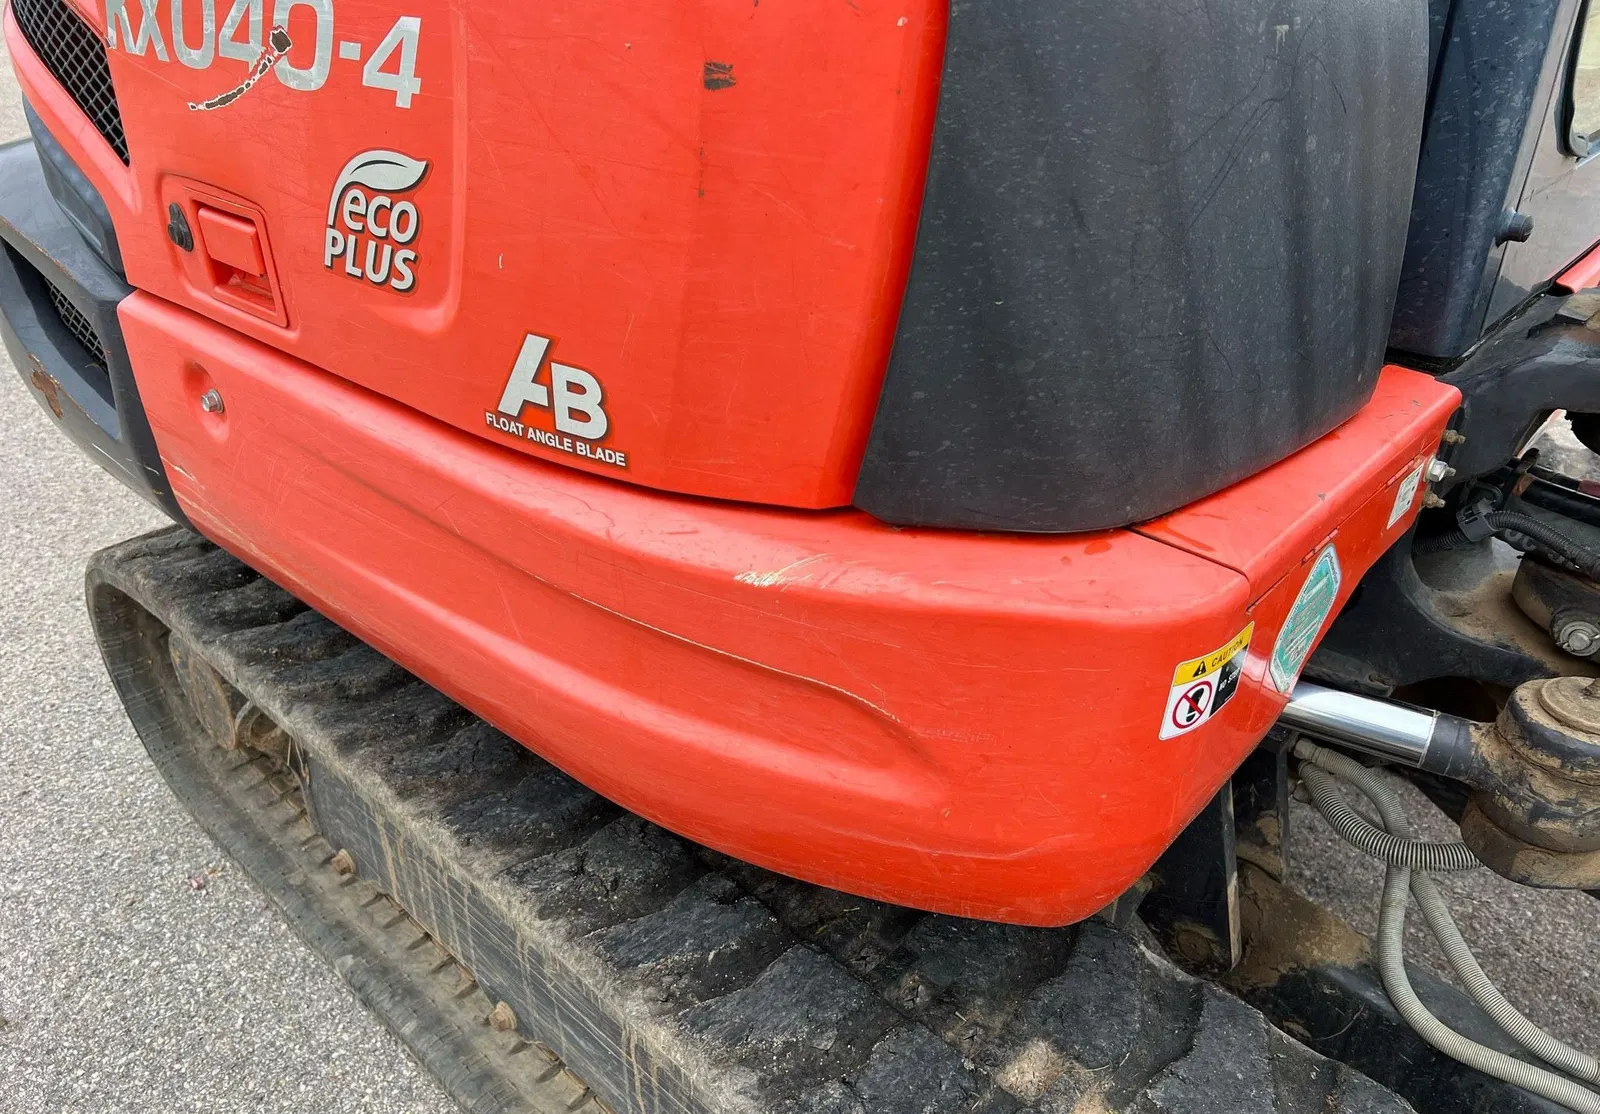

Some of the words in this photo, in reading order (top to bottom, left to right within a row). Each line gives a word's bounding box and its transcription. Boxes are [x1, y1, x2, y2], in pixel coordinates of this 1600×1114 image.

[324, 227, 417, 291] PLUS
[485, 412, 524, 437] FLOAT
[527, 427, 573, 453] ANGLE
[576, 441, 626, 467] BLADE
[1211, 637, 1243, 667] CAUTION
